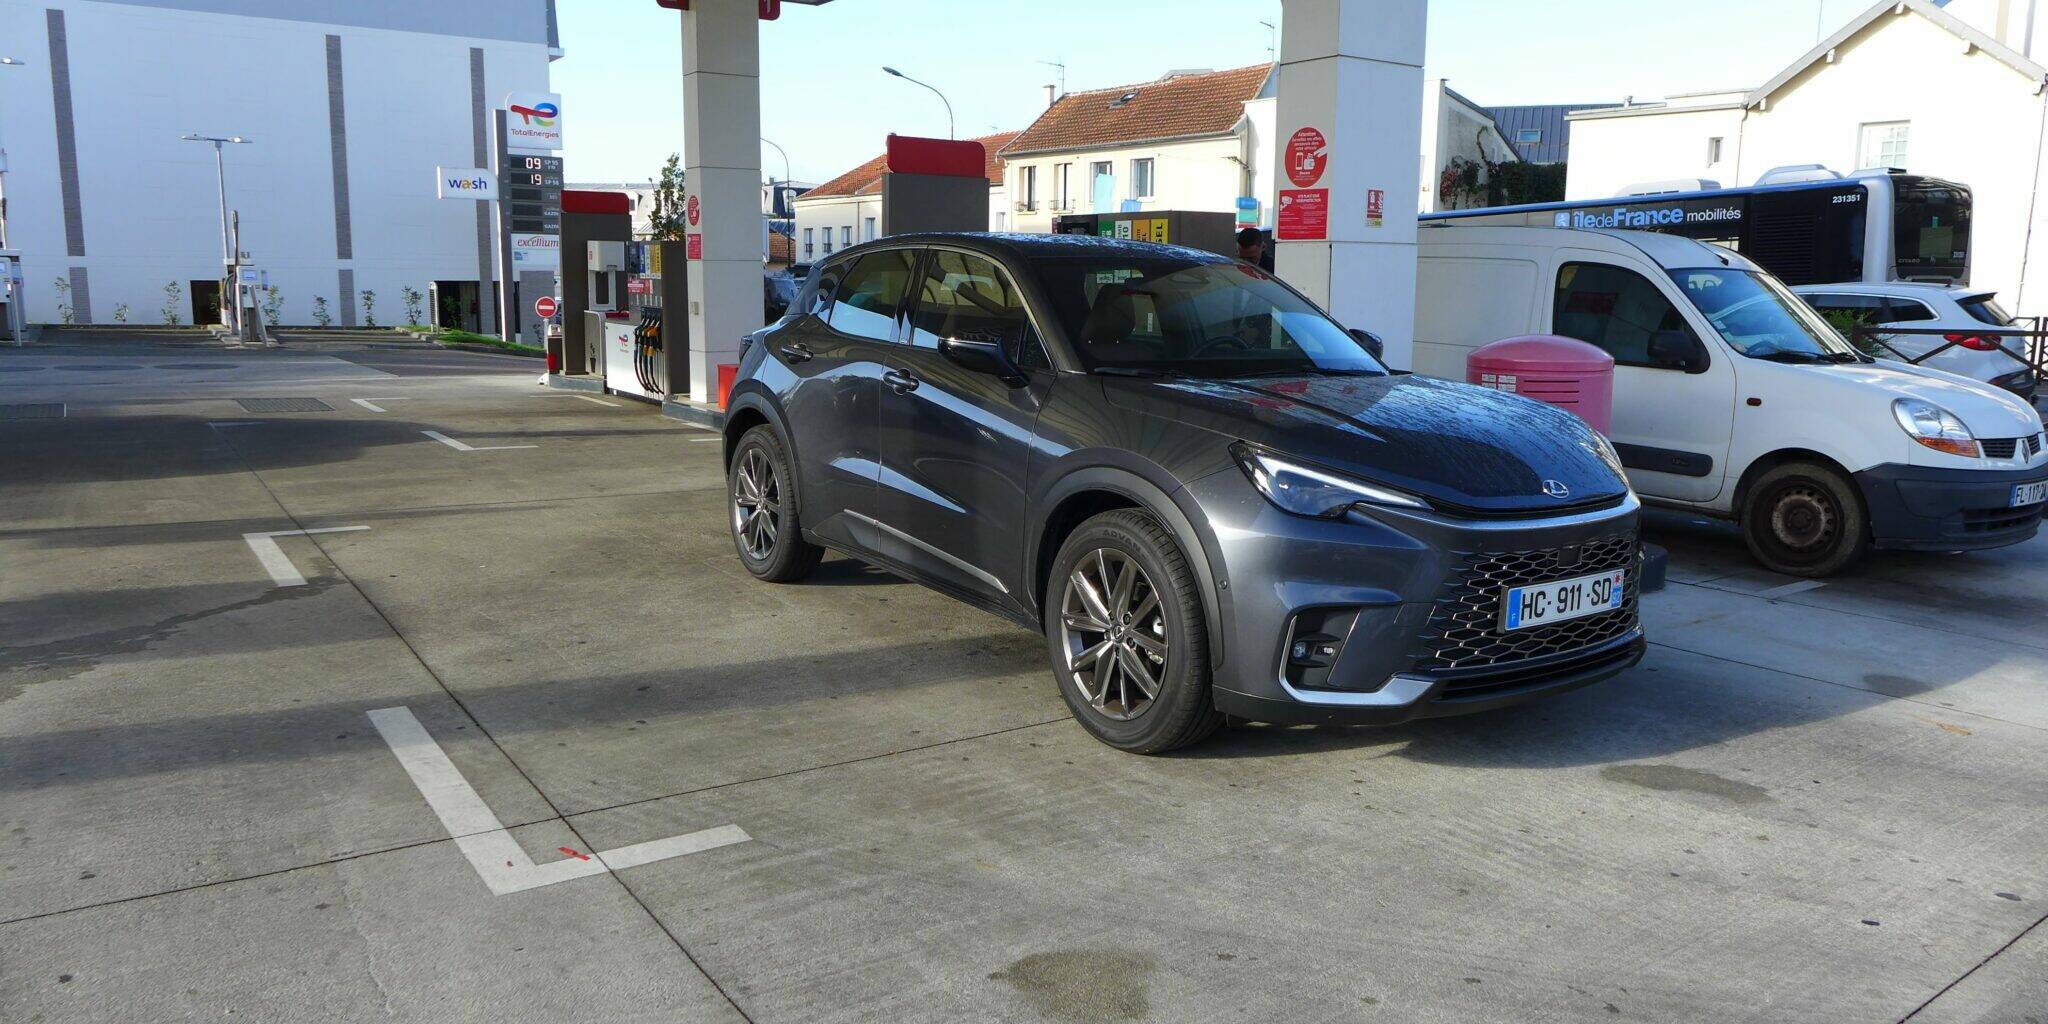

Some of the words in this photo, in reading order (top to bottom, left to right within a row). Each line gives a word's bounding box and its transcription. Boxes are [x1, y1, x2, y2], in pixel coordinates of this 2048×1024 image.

[511, 129, 560, 139] TotalEnergies
[526, 157, 542, 170] 09
[448, 177, 488, 190] wash
[530, 173, 542, 186] 19
[1832, 194, 1861, 204] 231351
[1686, 206, 1742, 222] mobilités
[517, 237, 559, 248] excellium
